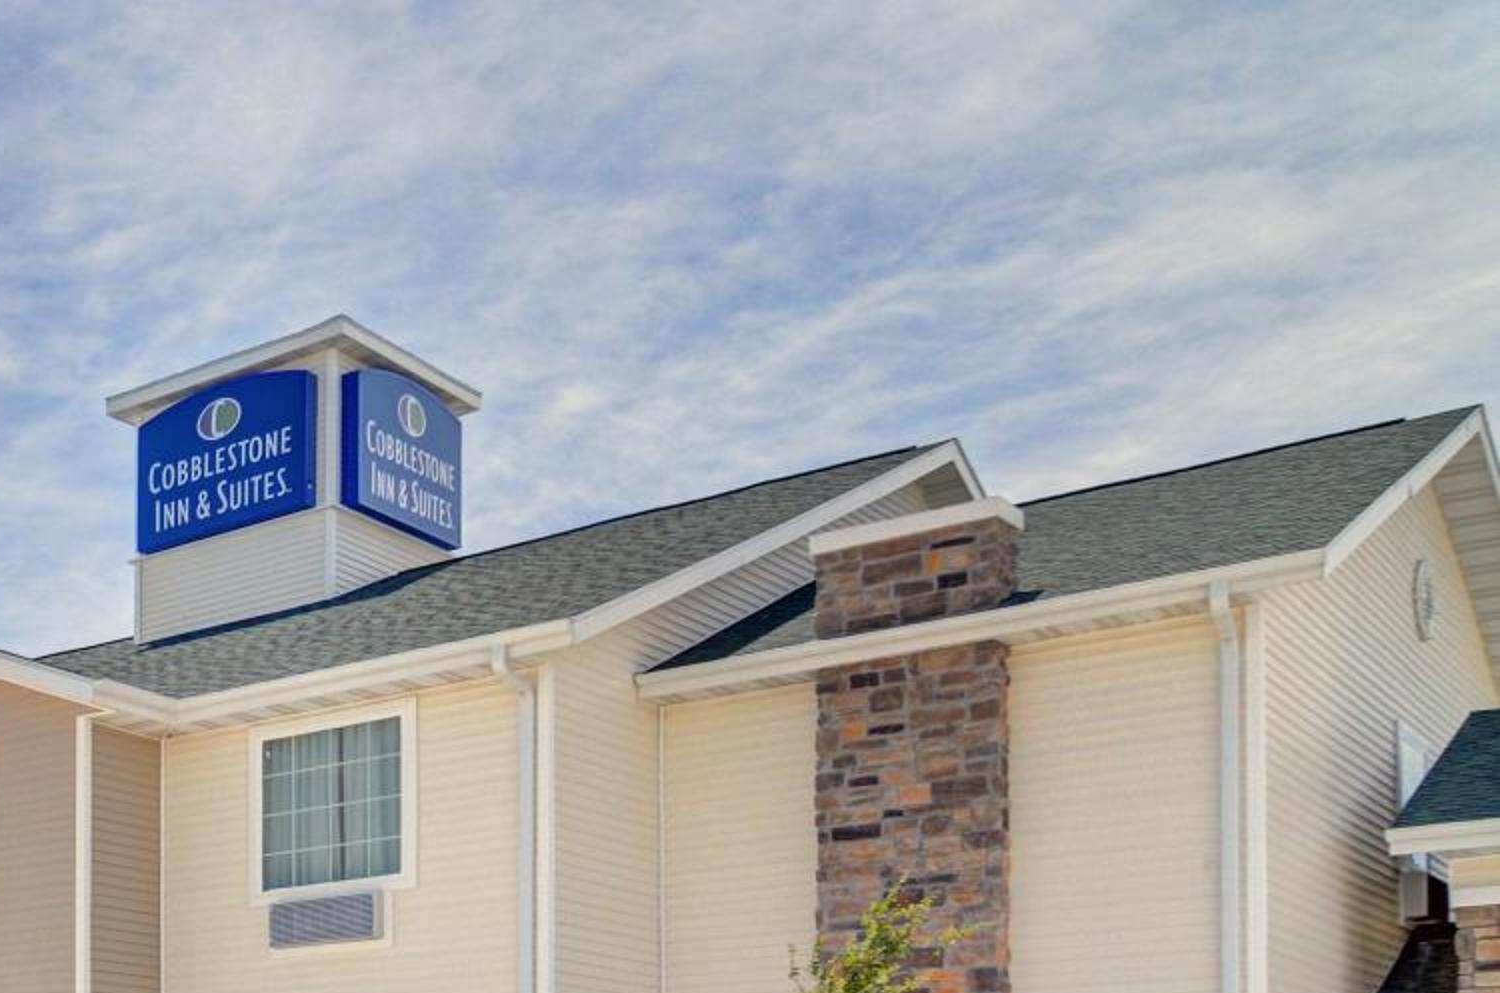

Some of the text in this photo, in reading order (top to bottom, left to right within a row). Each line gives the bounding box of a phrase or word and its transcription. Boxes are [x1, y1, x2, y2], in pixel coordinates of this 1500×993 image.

[149, 426, 292, 494] COBBLESTONE
[367, 419, 454, 492] COBBLESTONE
[155, 467, 287, 533] INN & SUITES
[371, 461, 453, 529] INN & SUITES
